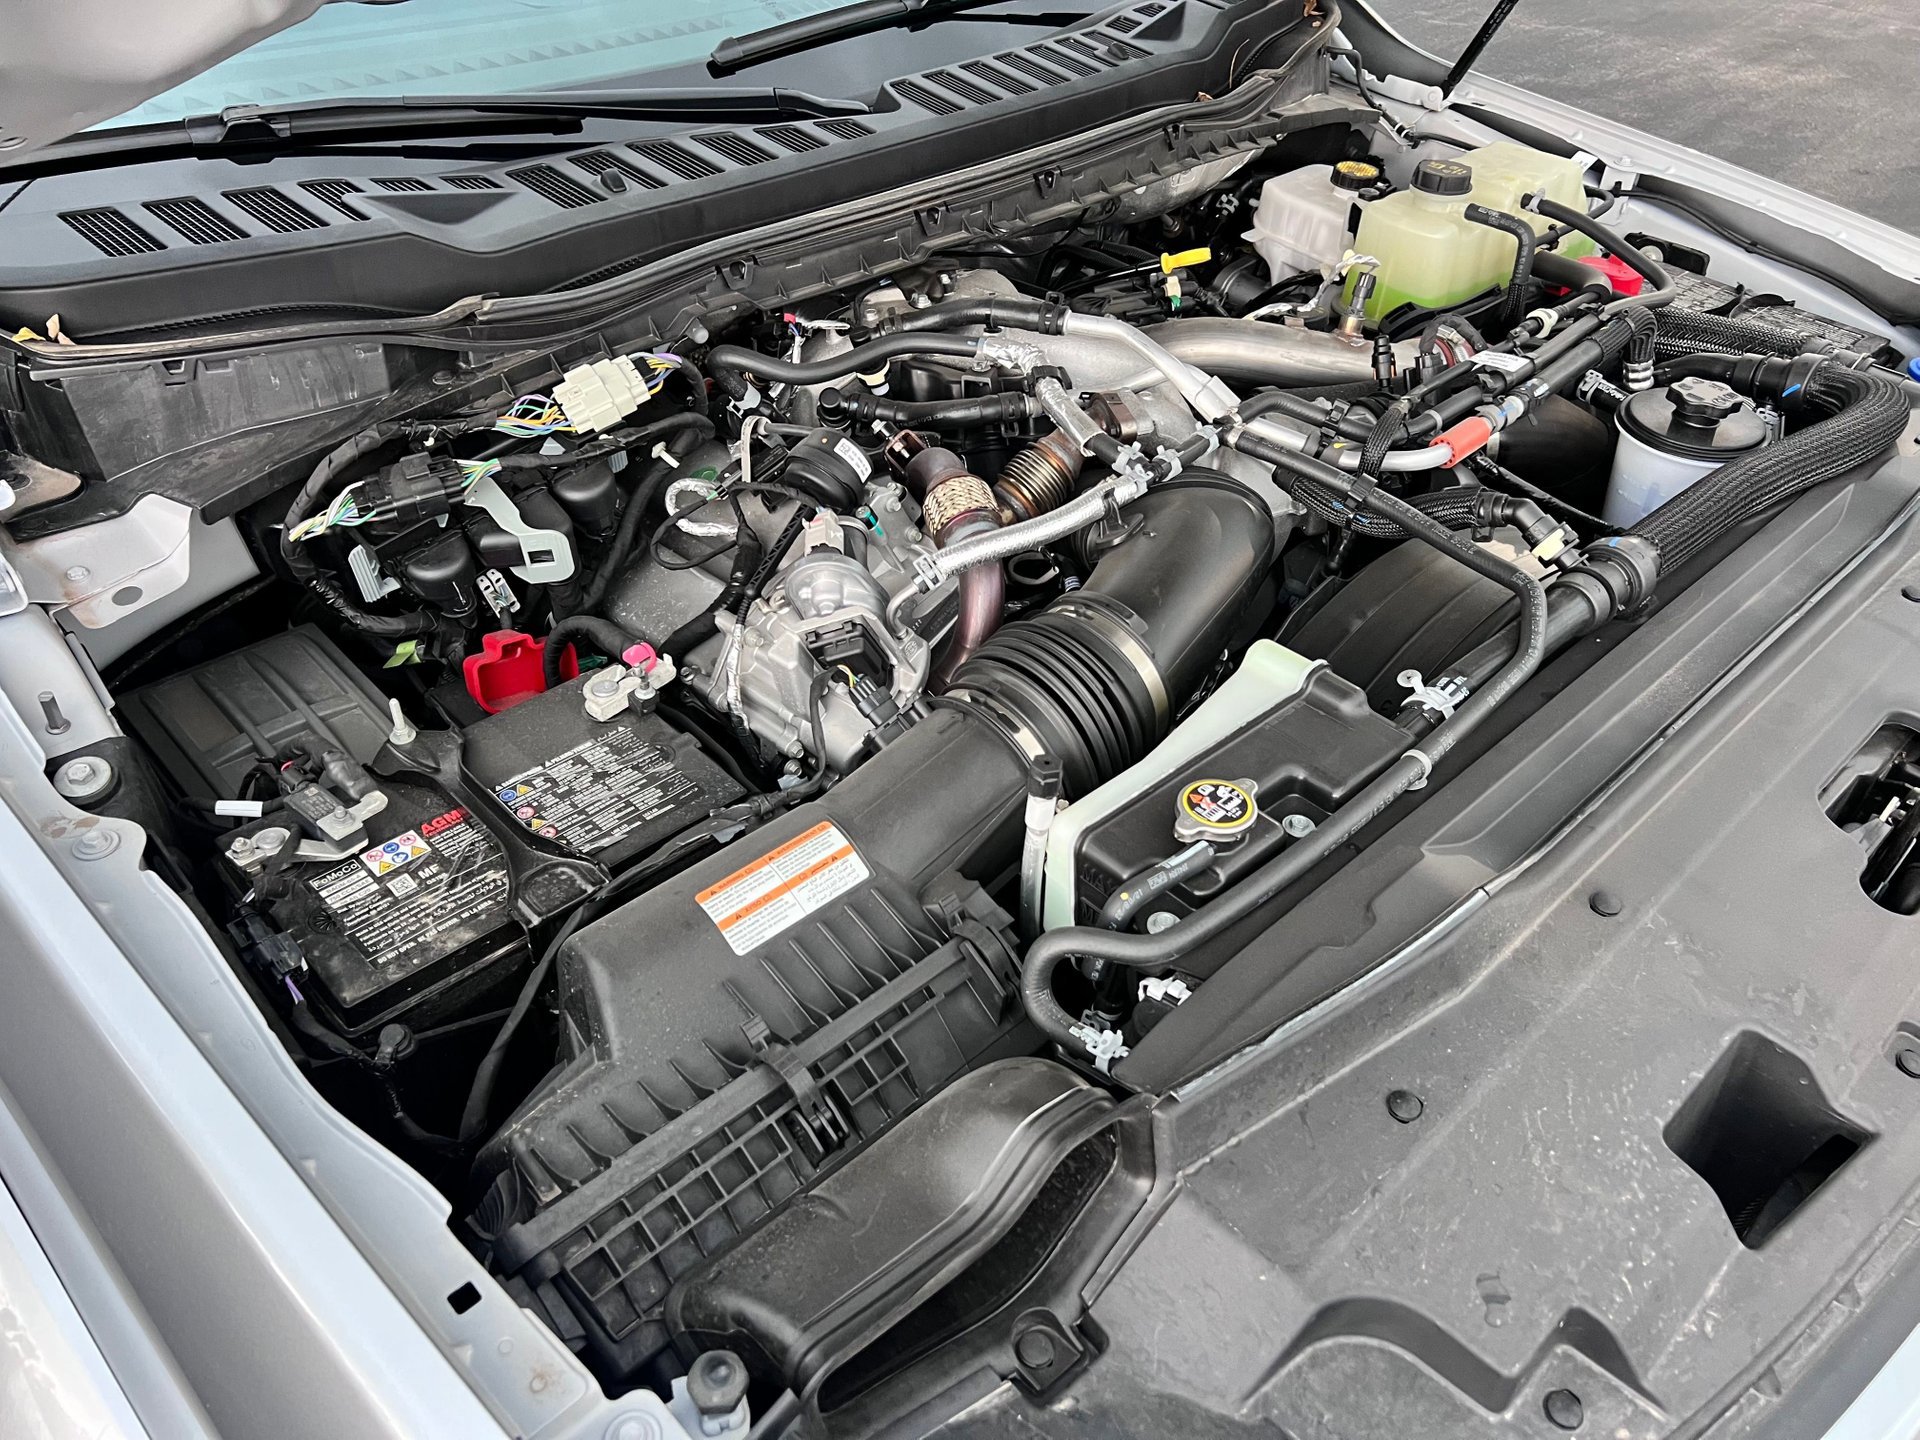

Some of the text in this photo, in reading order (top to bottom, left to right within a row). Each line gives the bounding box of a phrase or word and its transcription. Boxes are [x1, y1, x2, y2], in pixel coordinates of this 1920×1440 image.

[420, 808, 465, 835] AGM
[312, 862, 357, 887] FoMoCo
[418, 864, 440, 879] MF
